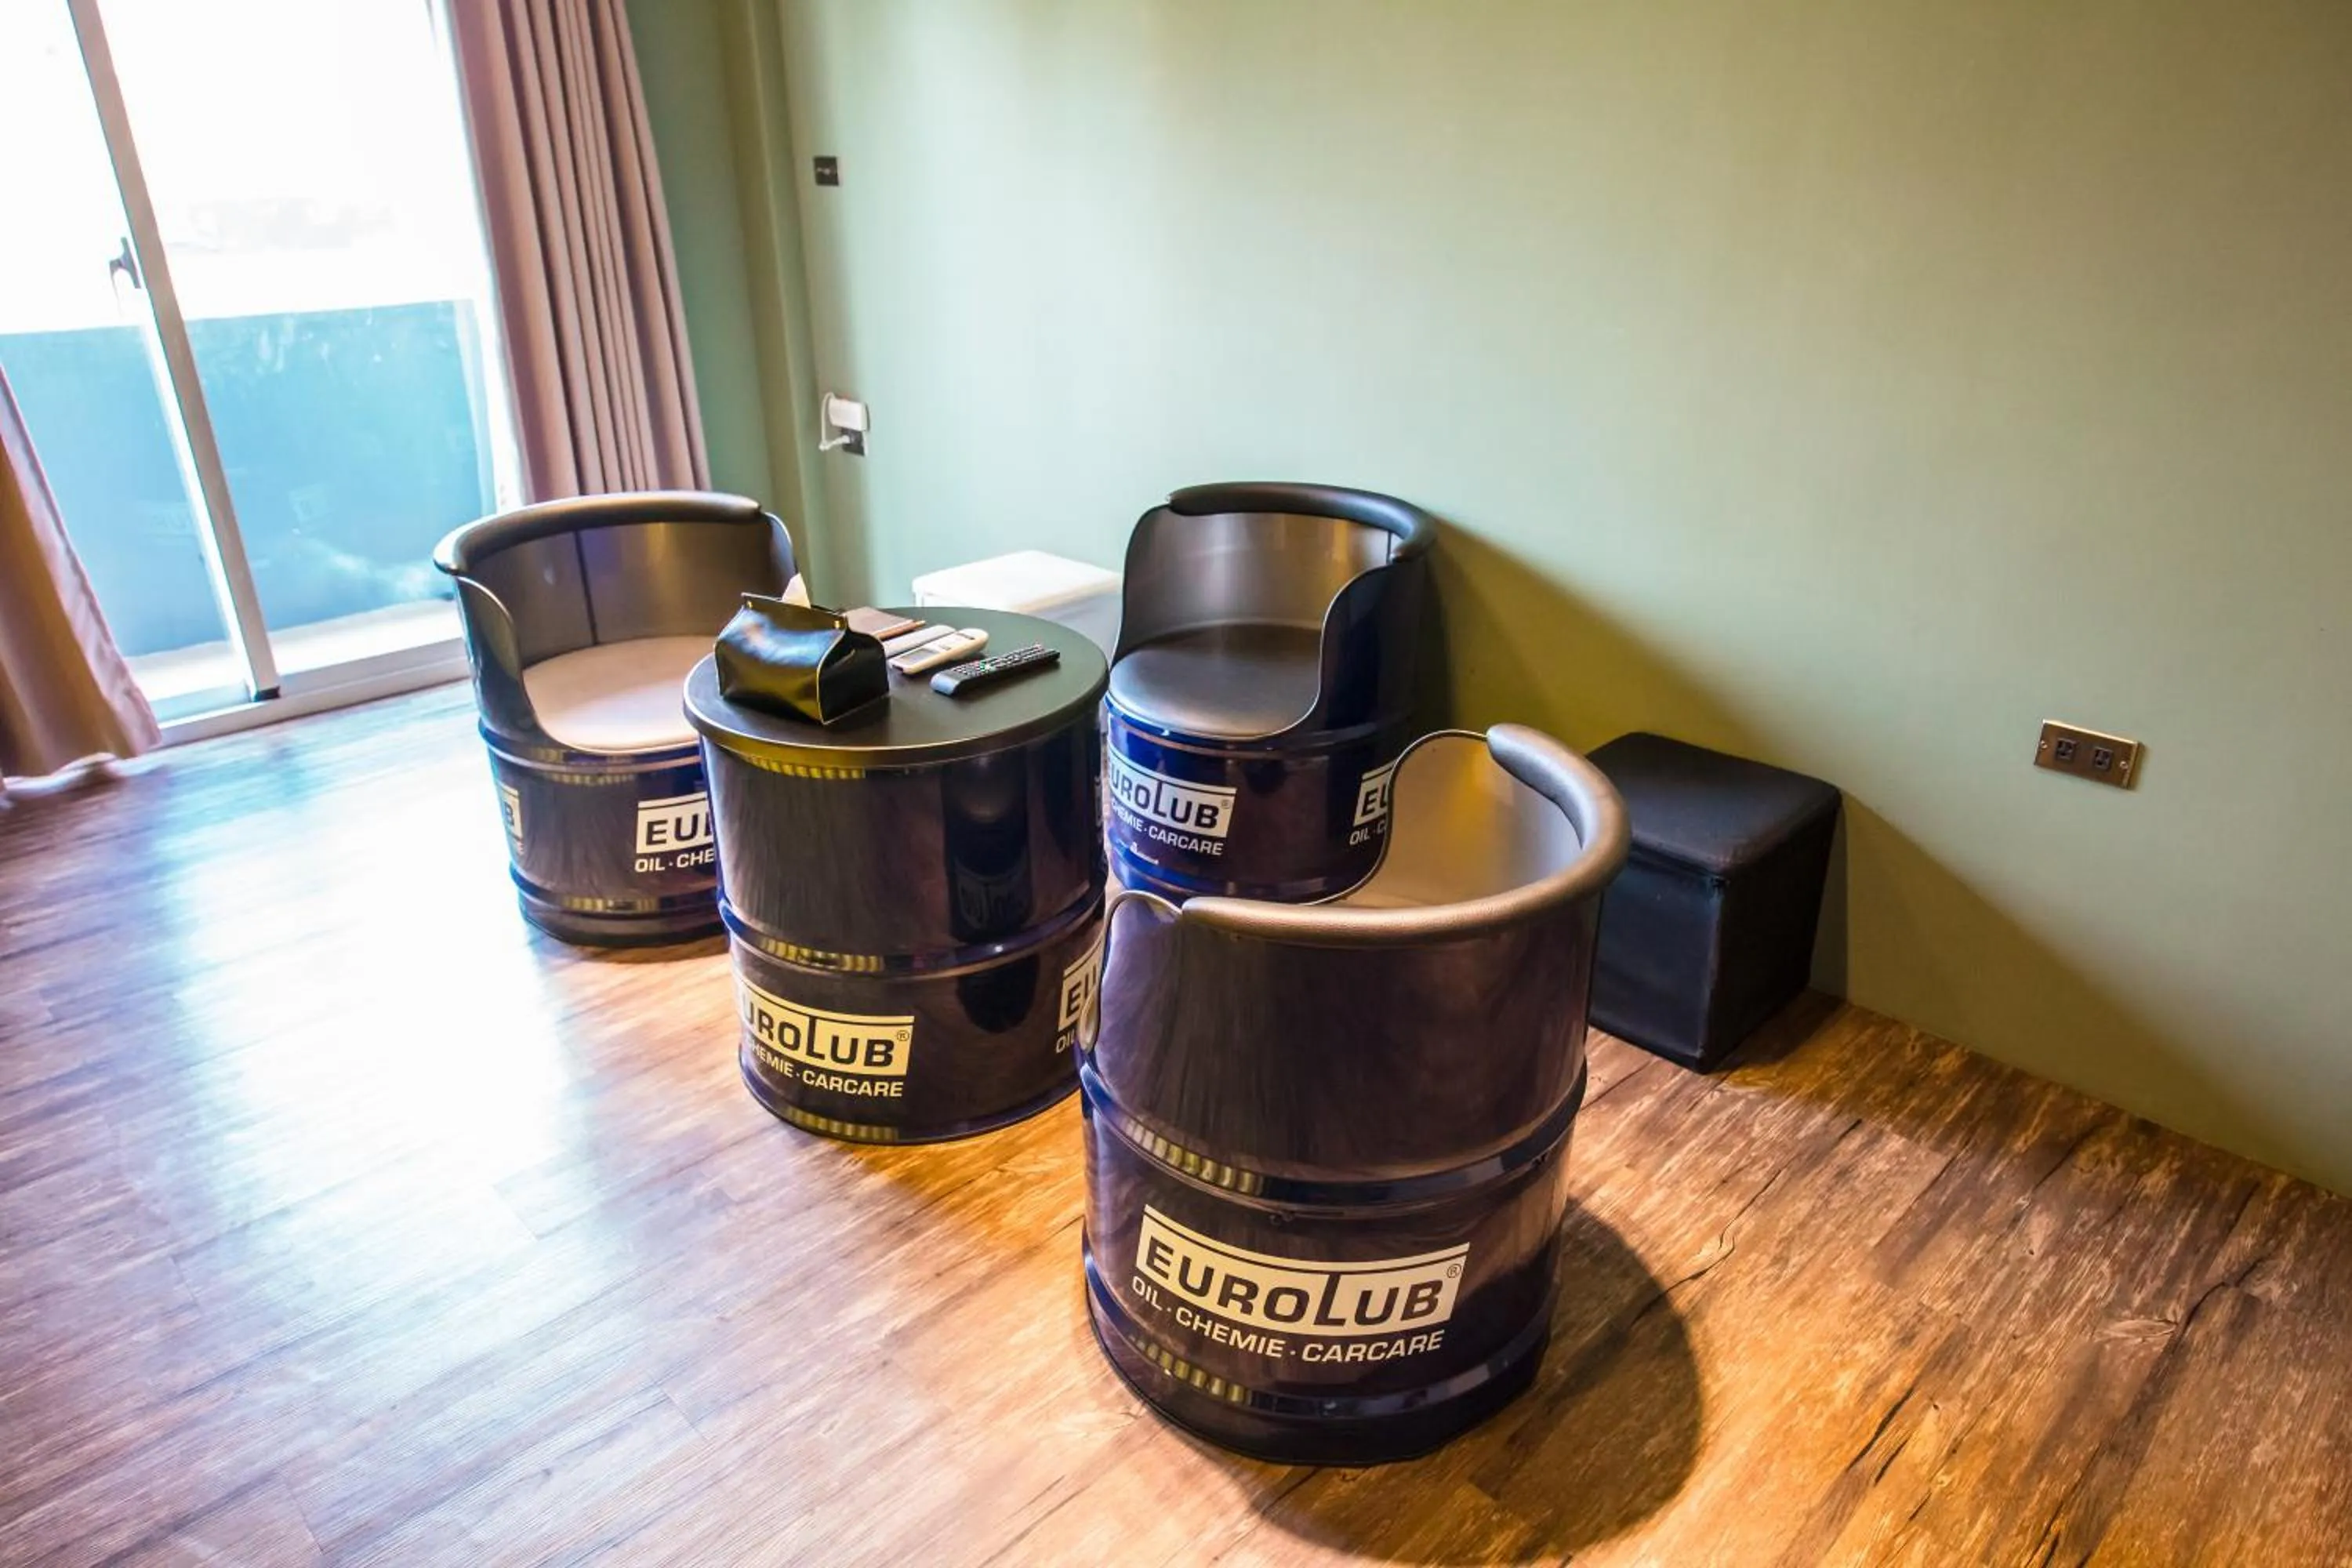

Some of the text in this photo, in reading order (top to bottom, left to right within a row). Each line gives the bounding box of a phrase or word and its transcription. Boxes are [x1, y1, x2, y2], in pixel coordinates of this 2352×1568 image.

[1112, 763, 1220, 829] UROLUB
[635, 856, 666, 873] OIL
[1149, 825, 1224, 856] CARCARE
[742, 993, 895, 1068] UROLUB
[803, 1069, 905, 1098] CARCARE
[1132, 1275, 1445, 1363] OIL CHEMIE CARCARE
